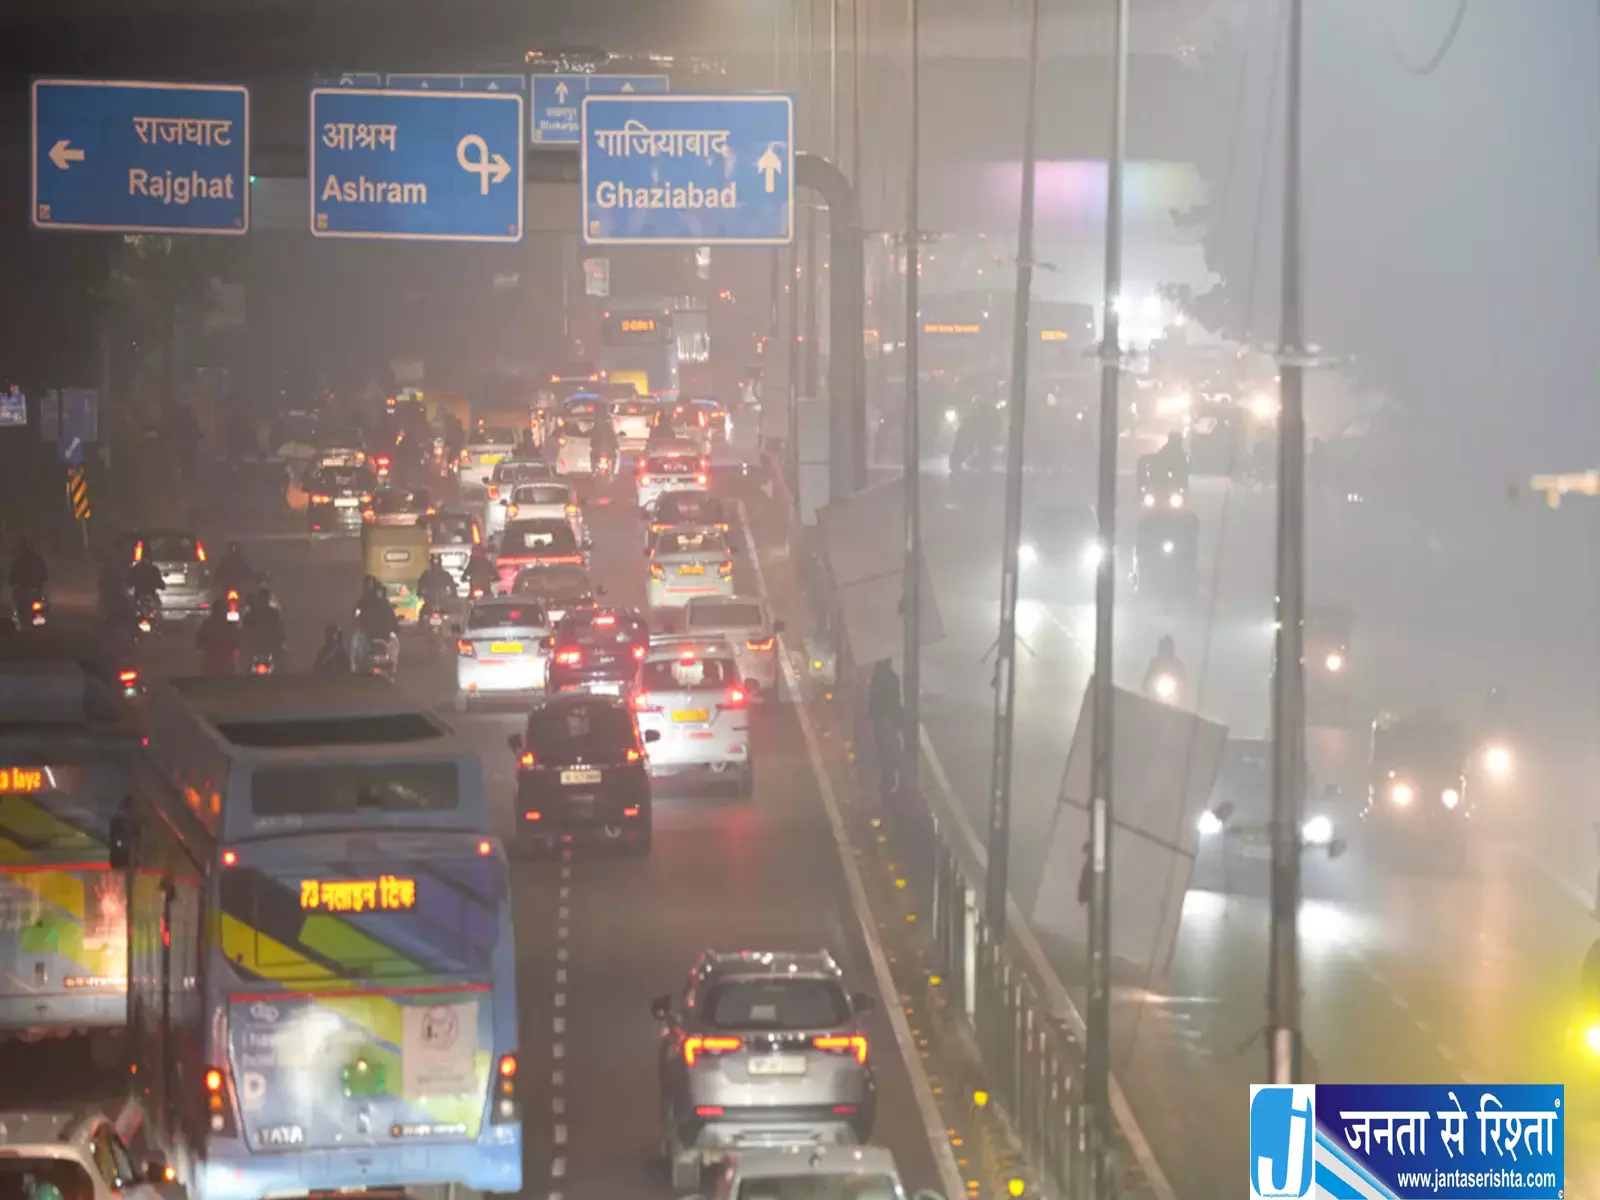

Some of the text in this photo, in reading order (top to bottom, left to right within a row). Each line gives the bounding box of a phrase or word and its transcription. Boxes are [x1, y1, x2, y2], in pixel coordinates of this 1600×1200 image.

[132, 116, 233, 146] राजघाट
[322, 123, 397, 152] आश्रम
[594, 119, 730, 157] गाजियाबाद
[128, 167, 235, 204] Rajghat
[321, 174, 427, 204] Ashram
[595, 180, 737, 209] Ghaziabad
